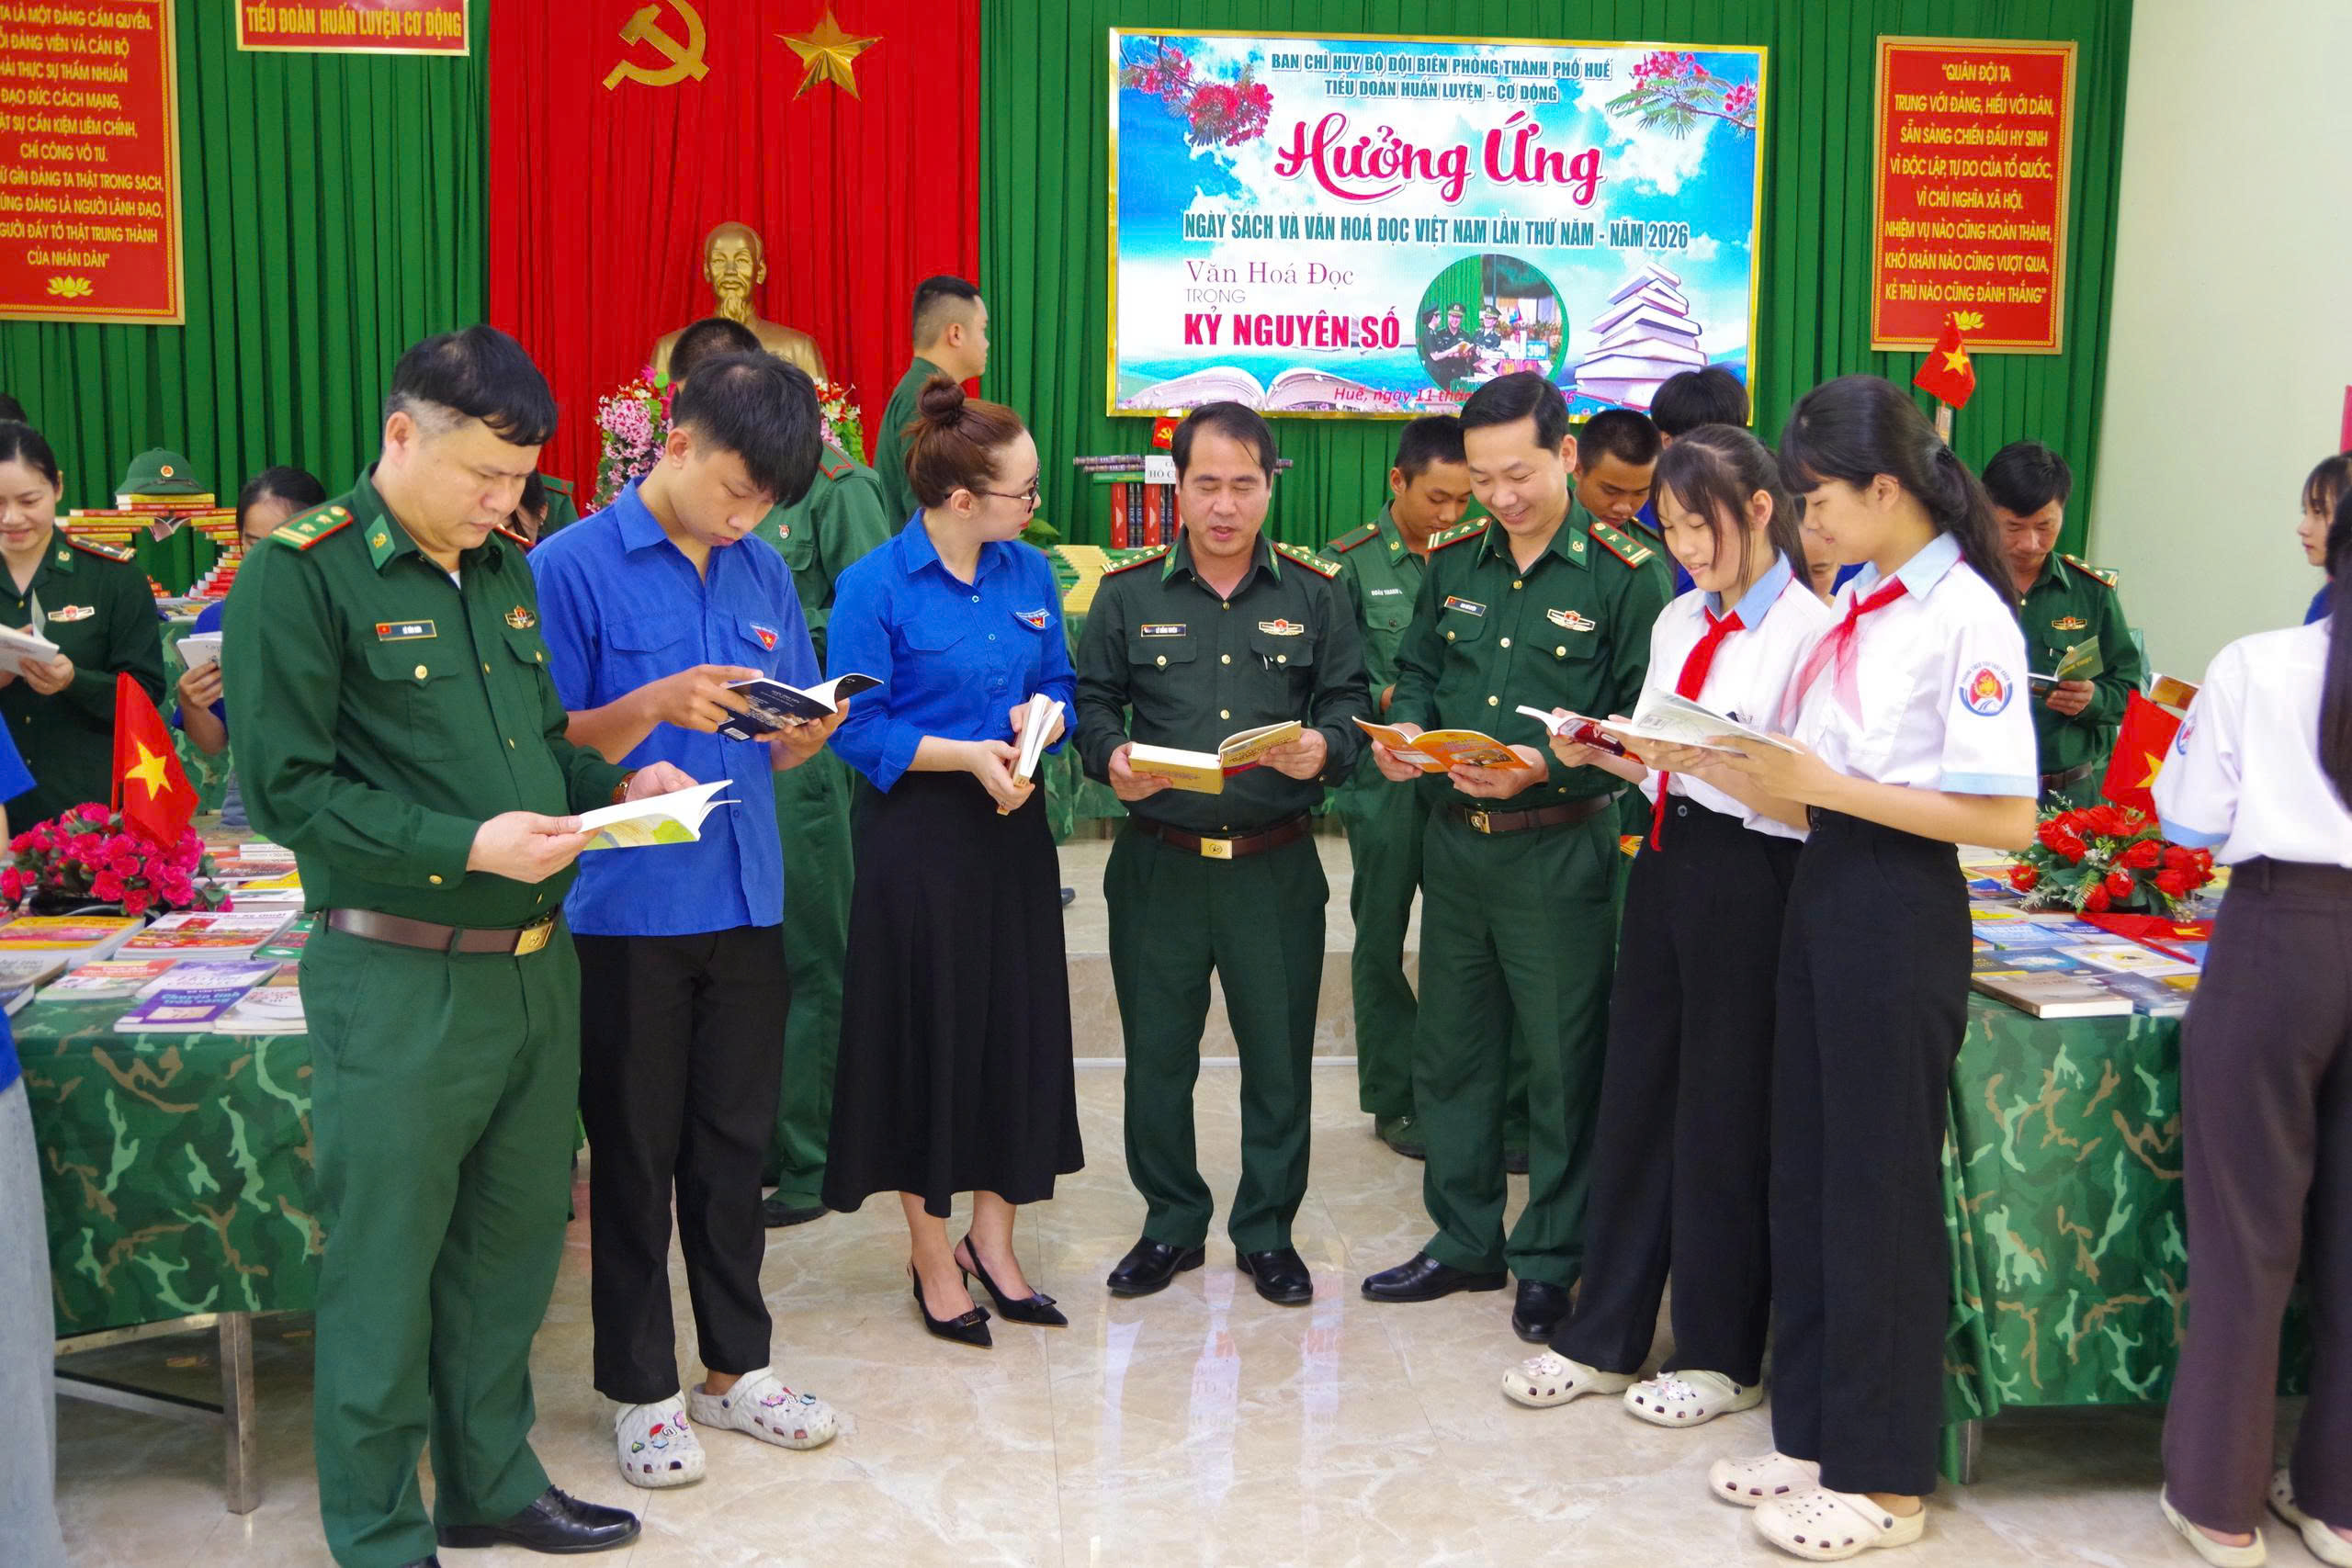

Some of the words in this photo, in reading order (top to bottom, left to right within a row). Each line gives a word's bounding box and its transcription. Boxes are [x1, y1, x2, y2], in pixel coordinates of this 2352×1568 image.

[246, 0, 276, 32] TIỂU
[279, 4, 315, 34] ĐOÀN
[320, 2, 356, 35] HUẤN
[425, 7, 461, 40] ĐỘNG
[0, 55, 15, 76] HẢI
[1272, 53, 1299, 69] BAN
[1304, 51, 1329, 70] CHỈ
[1333, 55, 1361, 71] HUY
[1365, 54, 1384, 73] BỘ
[1388, 54, 1412, 74] ĐỘI
[1417, 55, 1447, 73] BIÊN
[1453, 57, 1498, 74] PHÒNG
[1503, 58, 1547, 76] THÀNH
[1553, 57, 1581, 77] PHỐ
[1584, 58, 1613, 78] HUẾ
[1978, 61, 1997, 85] ĐỘI
[1999, 65, 2011, 82] TA
[1325, 74, 1354, 95] TIỂU
[1359, 77, 1396, 96] ĐOÀN
[1401, 77, 1437, 97] HUẤN
[1442, 81, 1482, 101] LUYỆN
[1497, 84, 1517, 99] CƠ
[1521, 83, 1557, 102] ĐỘNG
[1894, 94, 1928, 112] TRUNG
[1929, 90, 1948, 113] VỚI
[1950, 90, 1983, 116] ĐẢNG,
[1985, 91, 2007, 114] HIẾU
[2009, 93, 2028, 115] VỚI
[2029, 95, 2054, 118] DÂN,
[1900, 118, 1920, 143] SẴN
[1923, 122, 1951, 144] SÀNG
[1954, 122, 1984, 145] CHIẾN
[1986, 123, 2007, 146] ĐẤU
[2009, 130, 2024, 146] HY
[2025, 130, 2048, 147] SINH
[1273, 112, 1472, 203] Hưởng
[1484, 110, 1603, 205] Ứng
[1890, 152, 1902, 175] VÌ
[1903, 154, 1927, 179] ĐỘC
[1928, 155, 1946, 180] LẬP,
[1949, 159, 1962, 180] TỰ
[1962, 161, 1978, 176] DO
[1980, 154, 2002, 177] CỦA
[2004, 152, 2018, 177] TỔ
[2018, 156, 2052, 181] QUỐC,
[0, 191, 23, 211] ỨNG
[1917, 185, 1928, 207] VÌ
[1928, 185, 1950, 207] CHỦ
[1952, 188, 1984, 208] NGHĨA
[1986, 188, 2001, 209] XÃ
[0, 218, 25, 239] GƯỜI
[1185, 210, 1227, 238] NGÀY
[1231, 210, 1273, 240] SÁCH
[1279, 211, 1299, 241] VÀ
[1305, 212, 1335, 241] VĂN
[1340, 213, 1372, 242] HOÁ
[1377, 217, 1409, 246] ĐỌC
[1415, 214, 1448, 247] VIỆT
[1453, 220, 1487, 243] NAM
[1492, 212, 1520, 244] LẦN
[1525, 218, 1556, 245] THỨ
[1561, 218, 1594, 246] NĂM
[1610, 220, 1644, 248] NĂM
[1647, 224, 1688, 249] 2026
[1884, 217, 1915, 242] NHIỆM
[1917, 221, 1930, 243] VỤ
[1932, 217, 1955, 239] NÀO
[1956, 219, 1985, 240] CŨNG
[2018, 220, 2052, 243] THÀNH,
[27, 245, 50, 265] CỦA
[51, 248, 81, 266] NHÂN
[1884, 247, 1906, 269] KHÓ
[1908, 249, 1936, 270] KHĂN
[1939, 249, 1962, 270] NÀO
[1963, 250, 1995, 271] CŨNG
[1996, 254, 2024, 276] VƯỢT
[2024, 255, 2050, 276] QUA,
[1186, 260, 1237, 284] Văn
[1249, 261, 1297, 285] Hoá
[1307, 262, 1353, 289] Đọc
[1185, 288, 1246, 303] TRONG
[1885, 277, 1897, 299] KẺ
[1898, 278, 1917, 301] THÙ
[1919, 279, 1942, 302] NÀO
[1944, 281, 1974, 302] CŨNG
[1976, 281, 2006, 303] ĐÁNH
[1184, 305, 1223, 345] KỶ
[1233, 310, 1350, 347] NGUYÊN
[1361, 306, 1400, 348] SỐ
[1374, 388, 1412, 404] ngày
[1416, 389, 1432, 402] 11
[1438, 387, 1472, 402] thán
